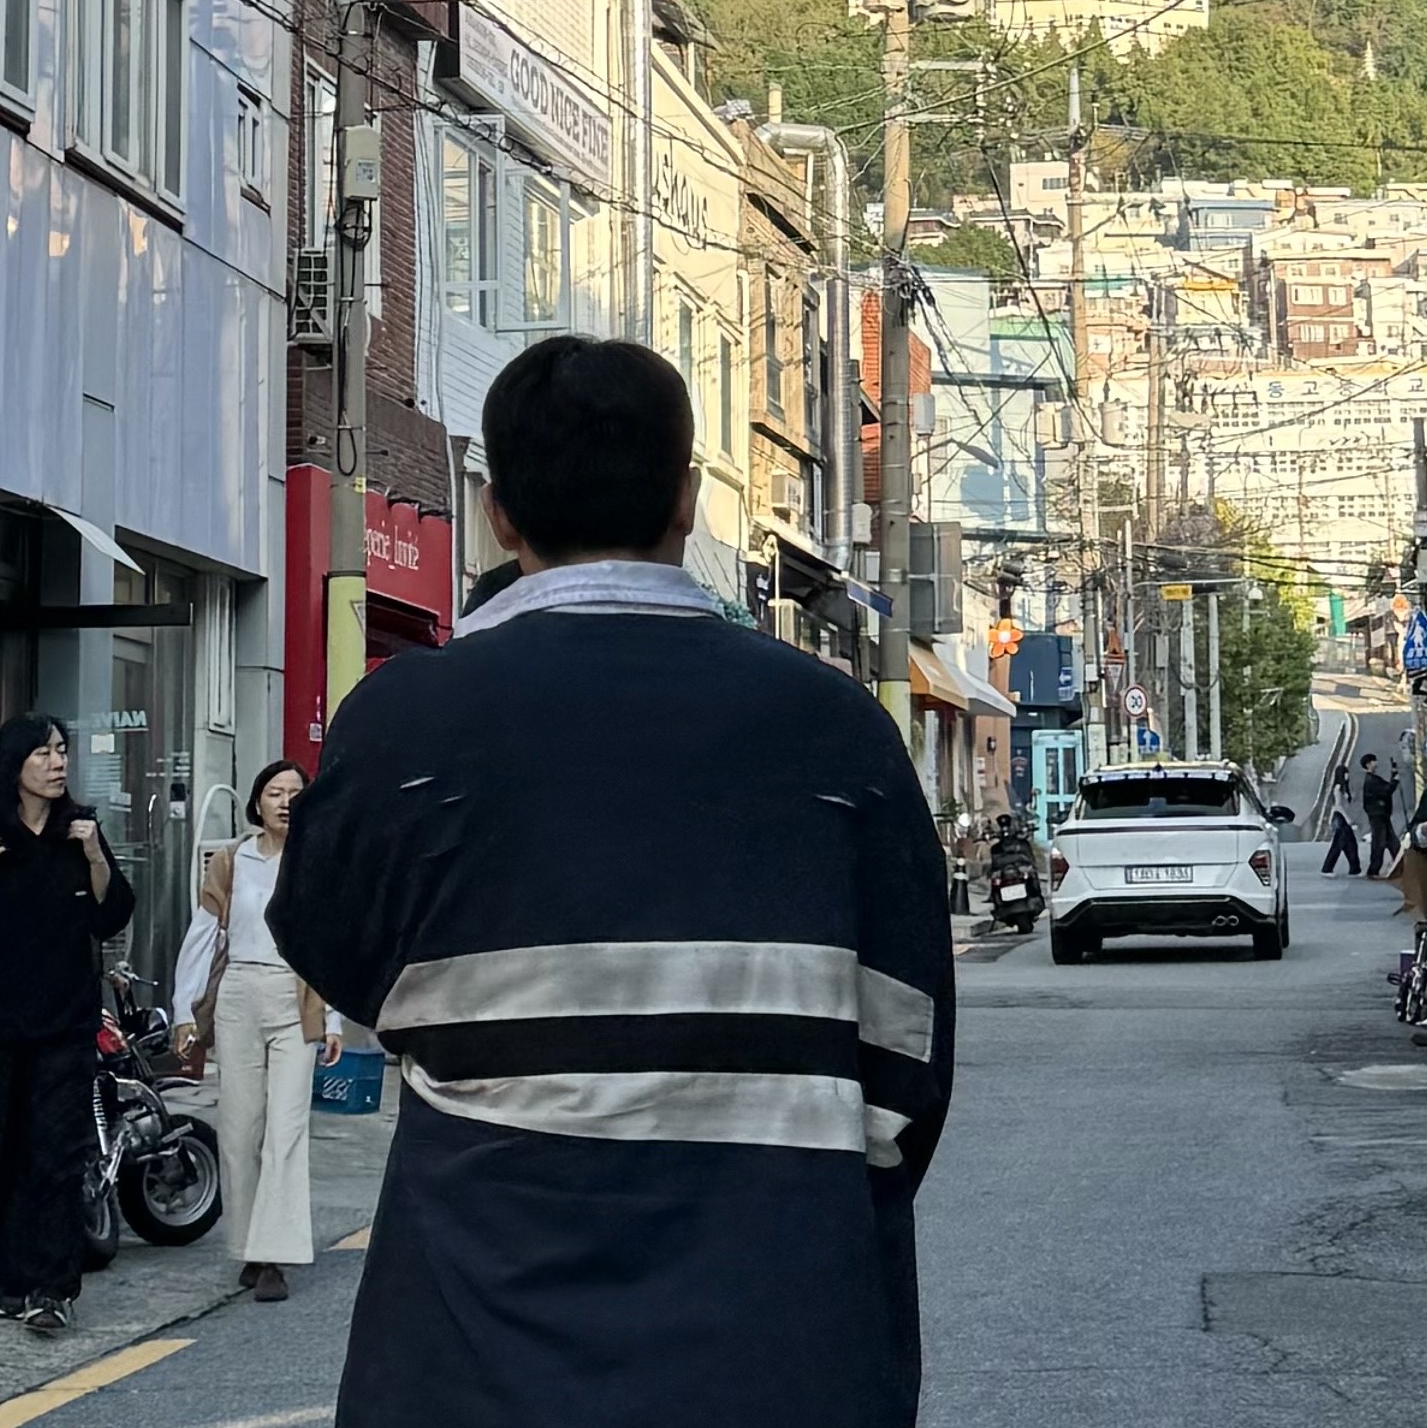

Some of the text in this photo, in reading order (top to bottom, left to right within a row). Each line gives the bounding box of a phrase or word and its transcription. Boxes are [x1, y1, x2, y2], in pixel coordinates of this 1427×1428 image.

[510, 49, 549, 115] GOOD
[550, 82, 580, 143] NICE
[581, 108, 609, 164] FINE
